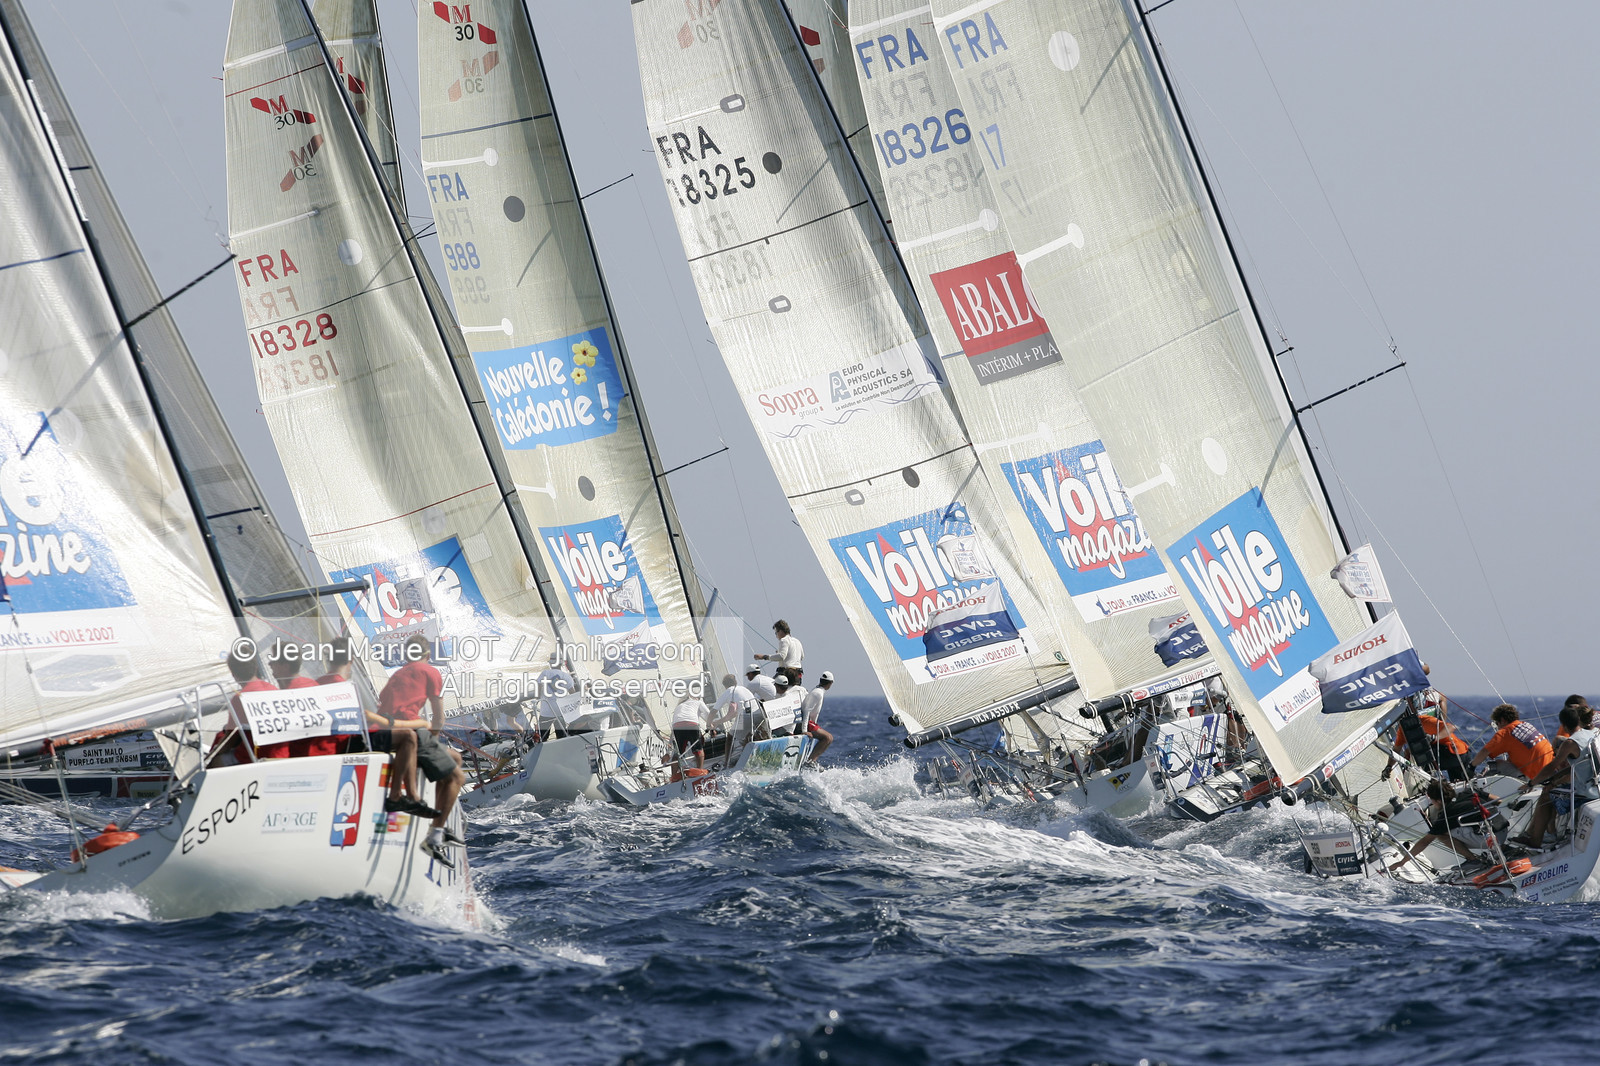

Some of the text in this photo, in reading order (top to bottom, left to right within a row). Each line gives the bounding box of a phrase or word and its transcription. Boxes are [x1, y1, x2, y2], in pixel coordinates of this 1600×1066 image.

[452, 4, 472, 24] M
[454, 24, 475, 41] 30
[945, 12, 1009, 70] FRA
[855, 28, 929, 79] FRA
[269, 95, 289, 115] M
[275, 112, 296, 130] 30
[656, 125, 722, 169] FRA
[875, 108, 972, 169] 18326
[979, 124, 1011, 171] 17
[427, 172, 470, 203] FRA
[666, 157, 757, 208] 18325
[238, 248, 299, 287] FRA
[443, 241, 481, 272] 988
[250, 312, 339, 359] 18328
[483, 350, 568, 403] Nouvelle
[842, 362, 864, 376] EURO
[847, 367, 886, 386] PHYSICAL
[853, 368, 913, 396] ACOUSTICS SA
[977, 356, 1021, 378] INTÉRIM
[758, 386, 819, 417] Sopra
[880, 389, 890, 397] Non
[496, 387, 596, 446] Calédonie
[798, 407, 819, 420] group
[1018, 453, 1134, 534] Voil
[548, 532, 629, 588] Voile
[1179, 524, 1283, 628] Voile
[1107, 599, 1127, 611] TOUR
[1131, 590, 1158, 604] FRANCE
[50, 628, 85, 643] VOILE
[85, 626, 114, 642] 2007
[1227, 589, 1310, 678] magazine
[934, 664, 950, 676] TOUR
[954, 660, 977, 671] FRANCE
[984, 650, 1002, 662] VOILE
[1001, 645, 1018, 657] 2007
[247, 697, 321, 717] ING ESPOIR
[334, 711, 358, 720] CIVIC
[256, 717, 290, 735] ESCP
[300, 713, 325, 728] EAP
[83, 747, 123, 757] SAINT MALO
[96, 757, 114, 765] TEAM
[182, 780, 260, 855] ESPOIR
[1337, 856, 1354, 864] CIVIC
